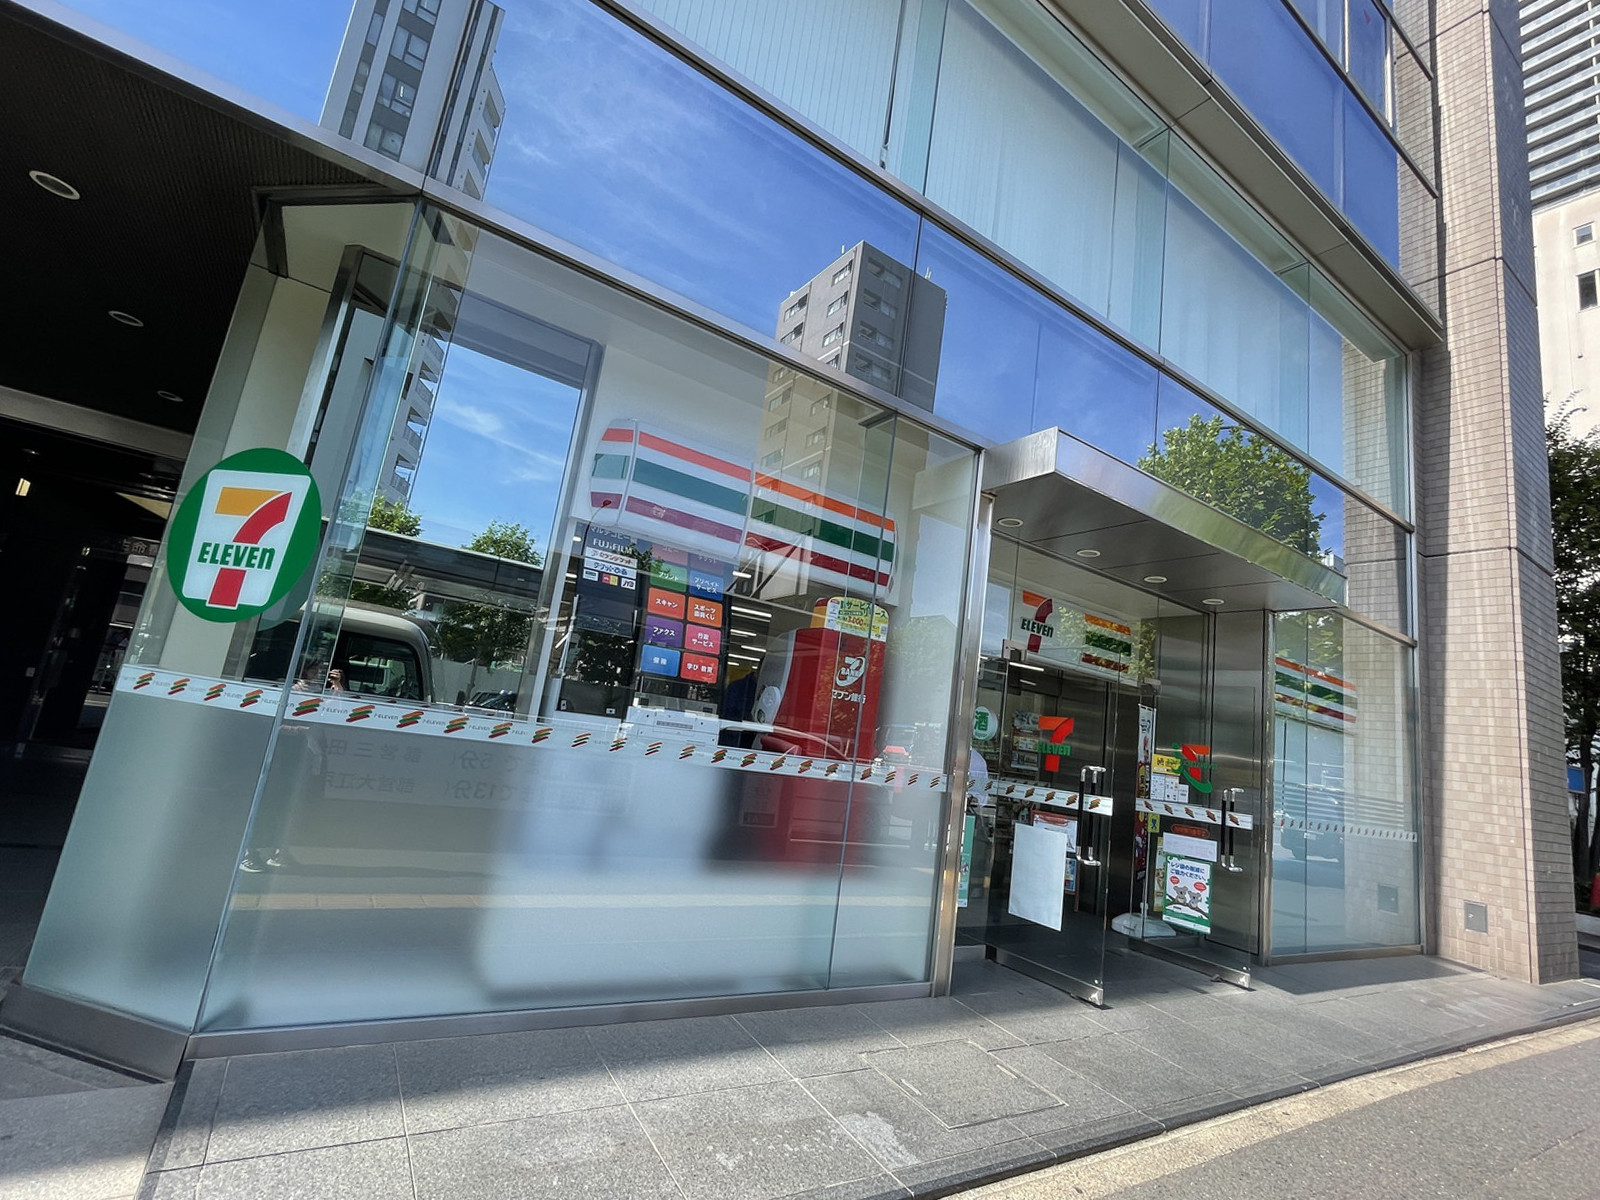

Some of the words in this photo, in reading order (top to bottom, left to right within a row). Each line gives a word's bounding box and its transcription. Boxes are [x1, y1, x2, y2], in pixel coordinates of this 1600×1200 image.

[658, 571, 679, 581] プリント
[655, 598, 678, 609] スキャン
[653, 626, 676, 637] ファクス
[691, 638, 714, 649] サービス
[974, 710, 990, 732] 酒
